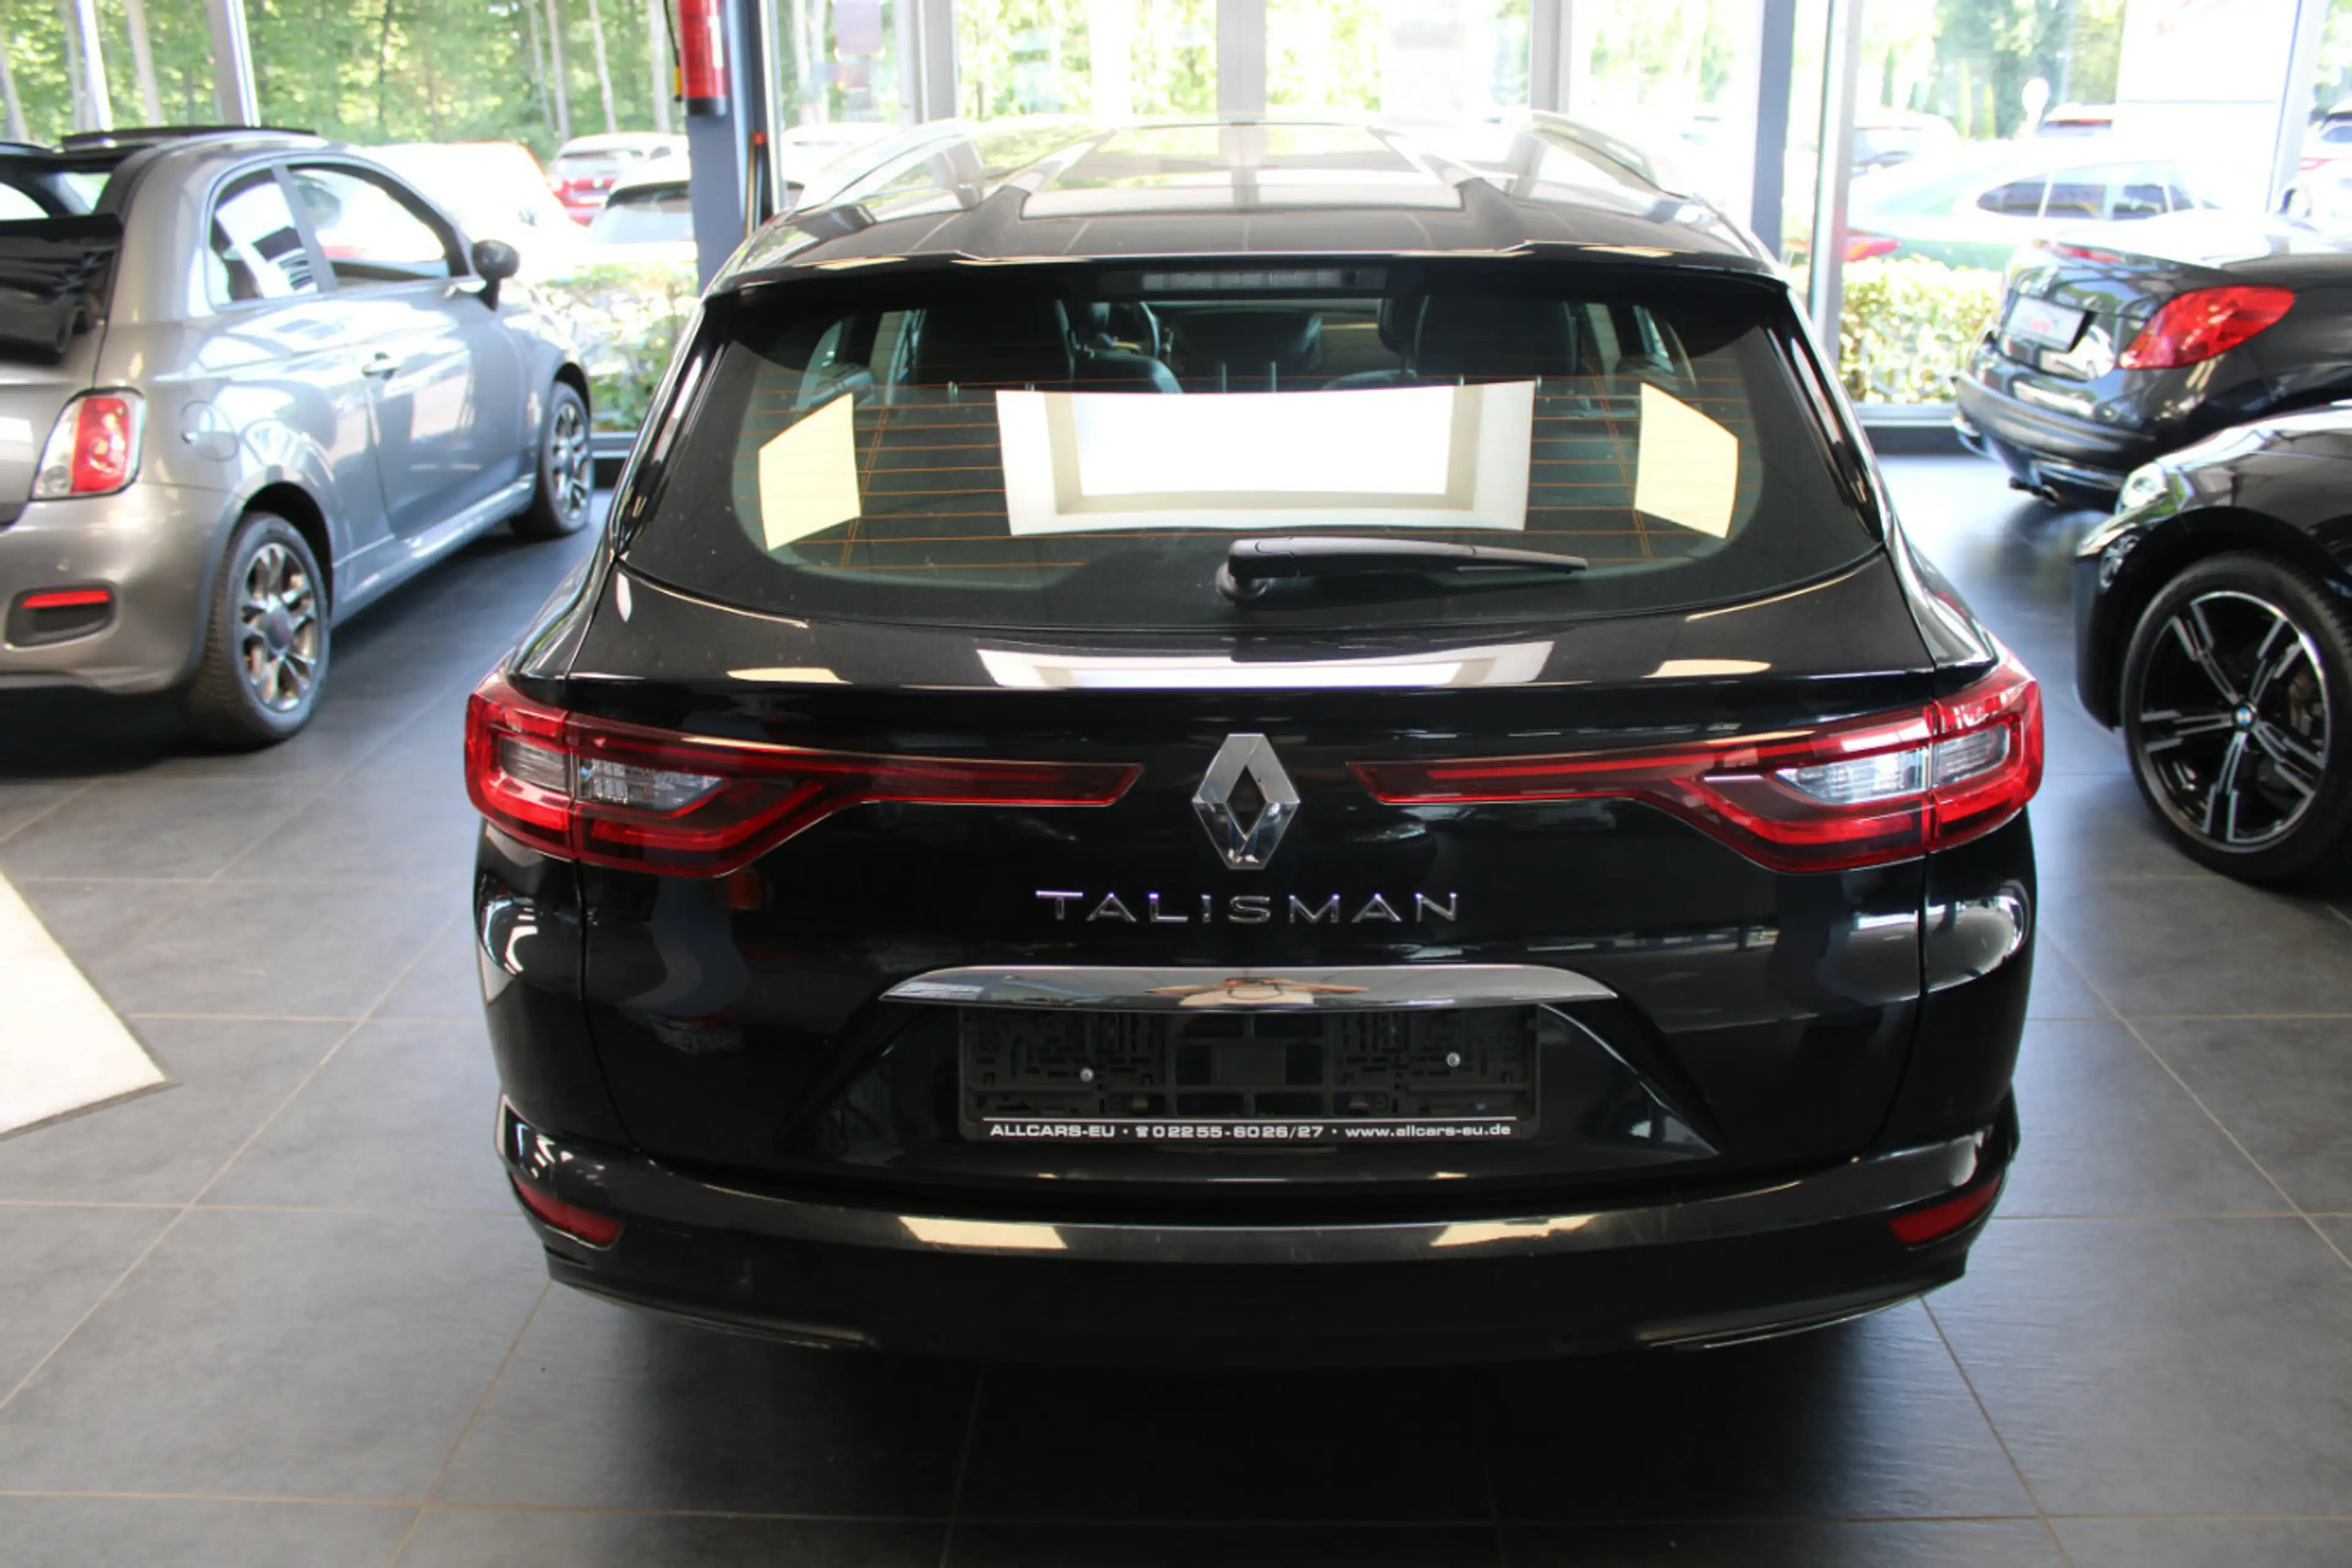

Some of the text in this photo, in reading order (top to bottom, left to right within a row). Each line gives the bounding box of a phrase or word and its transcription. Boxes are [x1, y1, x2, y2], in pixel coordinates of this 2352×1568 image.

[1035, 890, 1458, 922] TALISMAN
[990, 1125, 1115, 1137] ALLCARS-EU
[1345, 1123, 1512, 1138] www.allcars-eu.de
